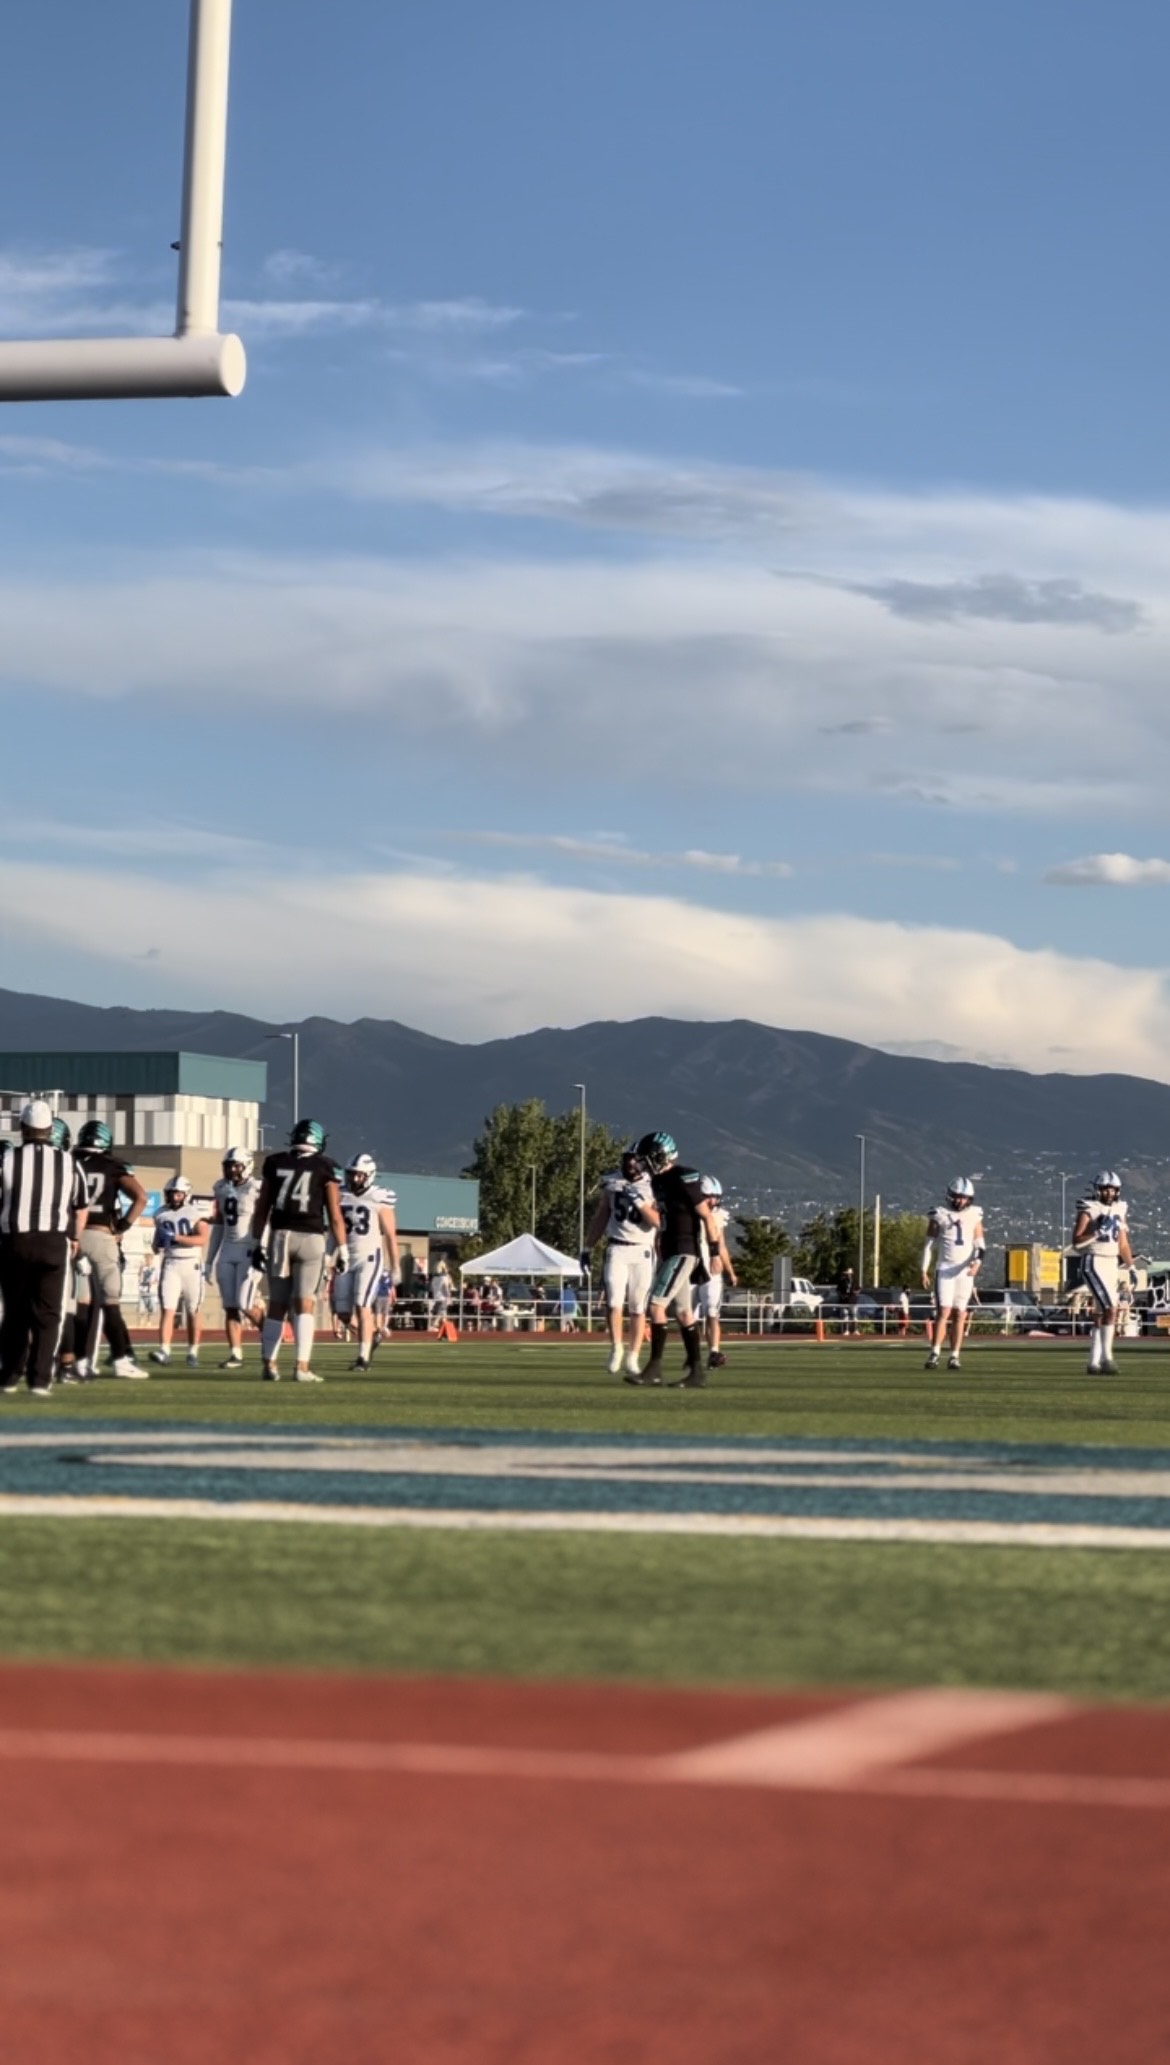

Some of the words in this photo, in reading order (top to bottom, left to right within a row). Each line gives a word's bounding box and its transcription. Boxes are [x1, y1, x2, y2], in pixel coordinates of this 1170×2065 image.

[276, 1169, 313, 1213] 74
[225, 1196, 240, 1227] 9
[341, 1204, 371, 1236] 53
[953, 1219, 964, 1246] 1
